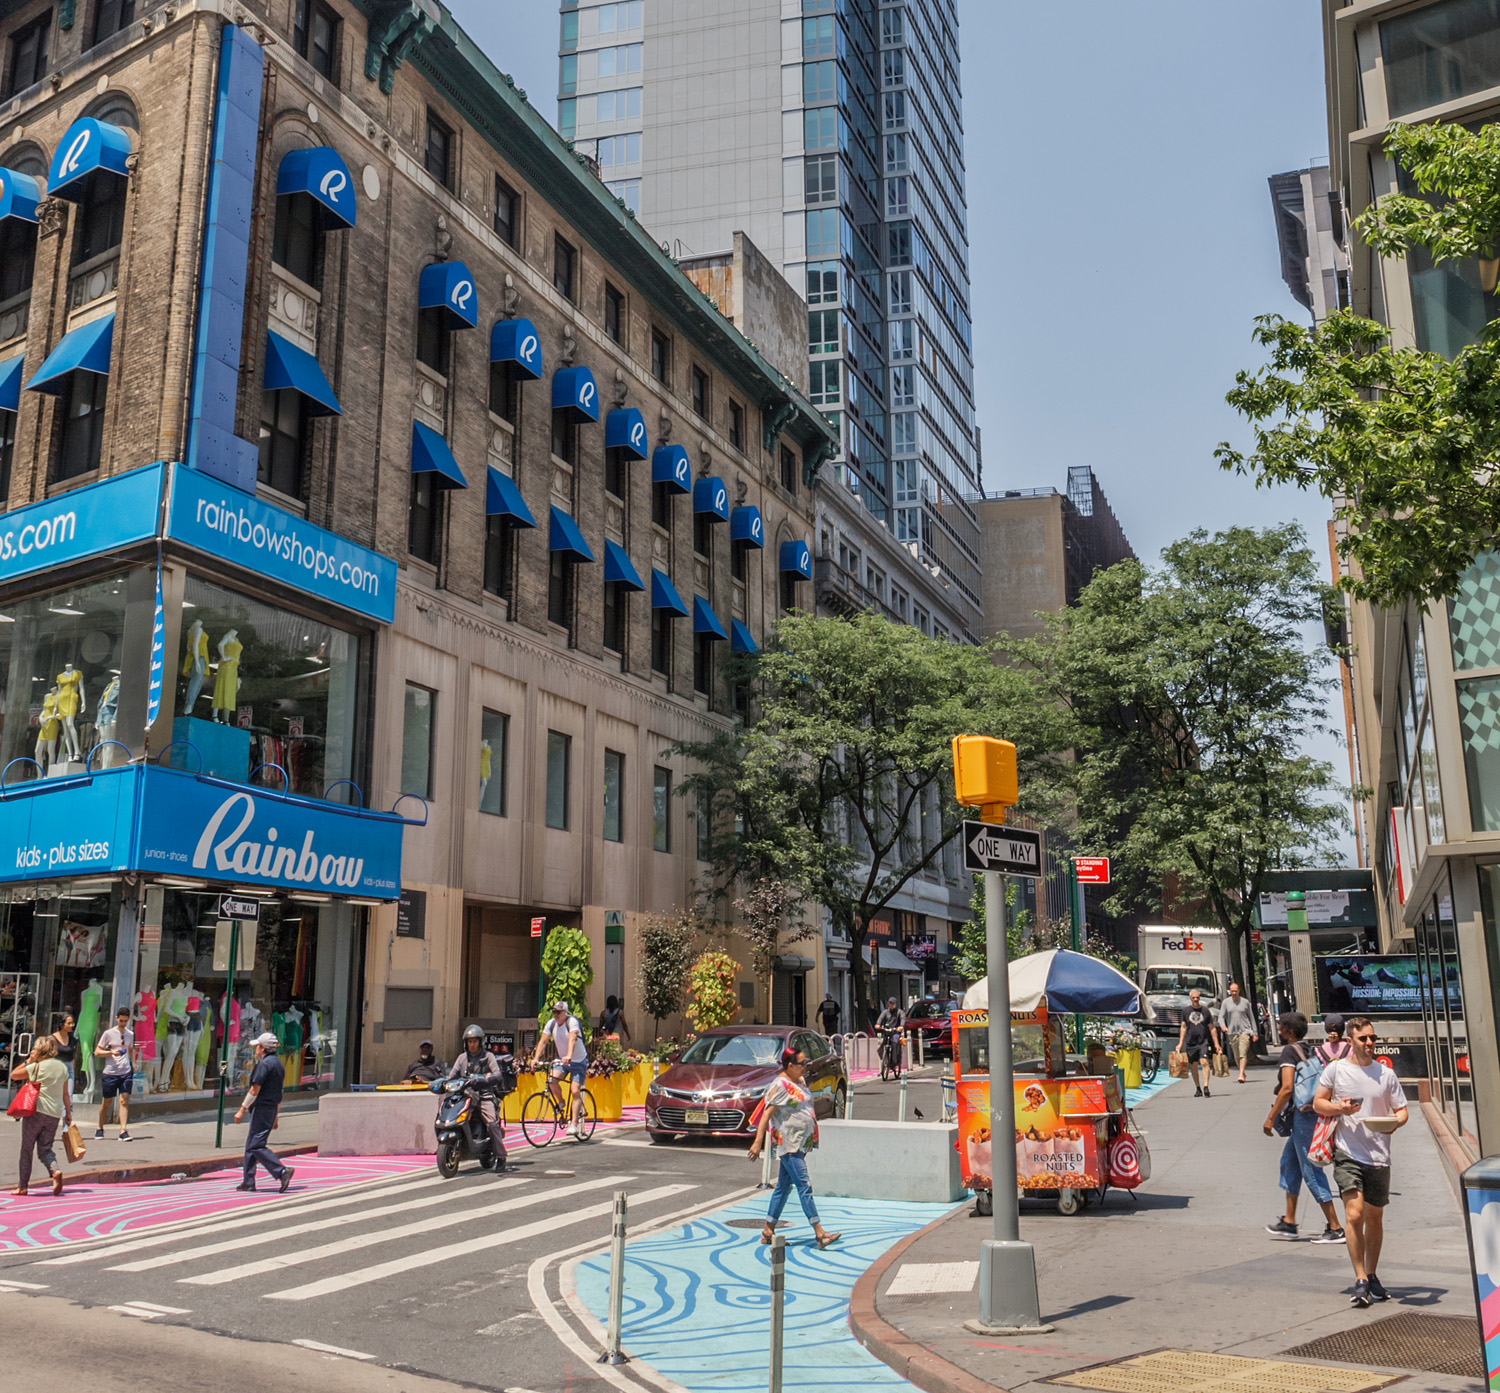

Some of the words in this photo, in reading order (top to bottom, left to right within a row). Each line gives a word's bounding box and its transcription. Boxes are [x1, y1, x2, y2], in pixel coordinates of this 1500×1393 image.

[59, 130, 90, 178] R
[320, 170, 346, 202] R
[452, 281, 472, 309] R
[520, 336, 537, 362] R
[580, 382, 594, 407] R
[631, 423, 643, 446] R
[196, 498, 379, 597] rainbowshops.com
[192, 792, 364, 888] Rainbow
[977, 838, 1000, 858] ONE
[1009, 842, 1032, 862] WAY
[16, 845, 41, 868] kids
[48, 841, 77, 870] plus
[78, 839, 109, 862] sizes
[144, 846, 166, 859] juniors
[169, 851, 188, 862] shoes
[225, 902, 237, 912] ONE
[242, 903, 255, 914] WAY
[1162, 937, 1204, 951] FedEx
[1352, 988, 1381, 998] MISSION:
[1382, 988, 1421, 997] IMPOSSIBLE
[958, 1013, 988, 1024] ROAS
[489, 1035, 513, 1044] Station
[1374, 1045, 1400, 1055] tation
[1033, 1153, 1084, 1162] ROASTED
[1046, 1162, 1076, 1171] NUTS
